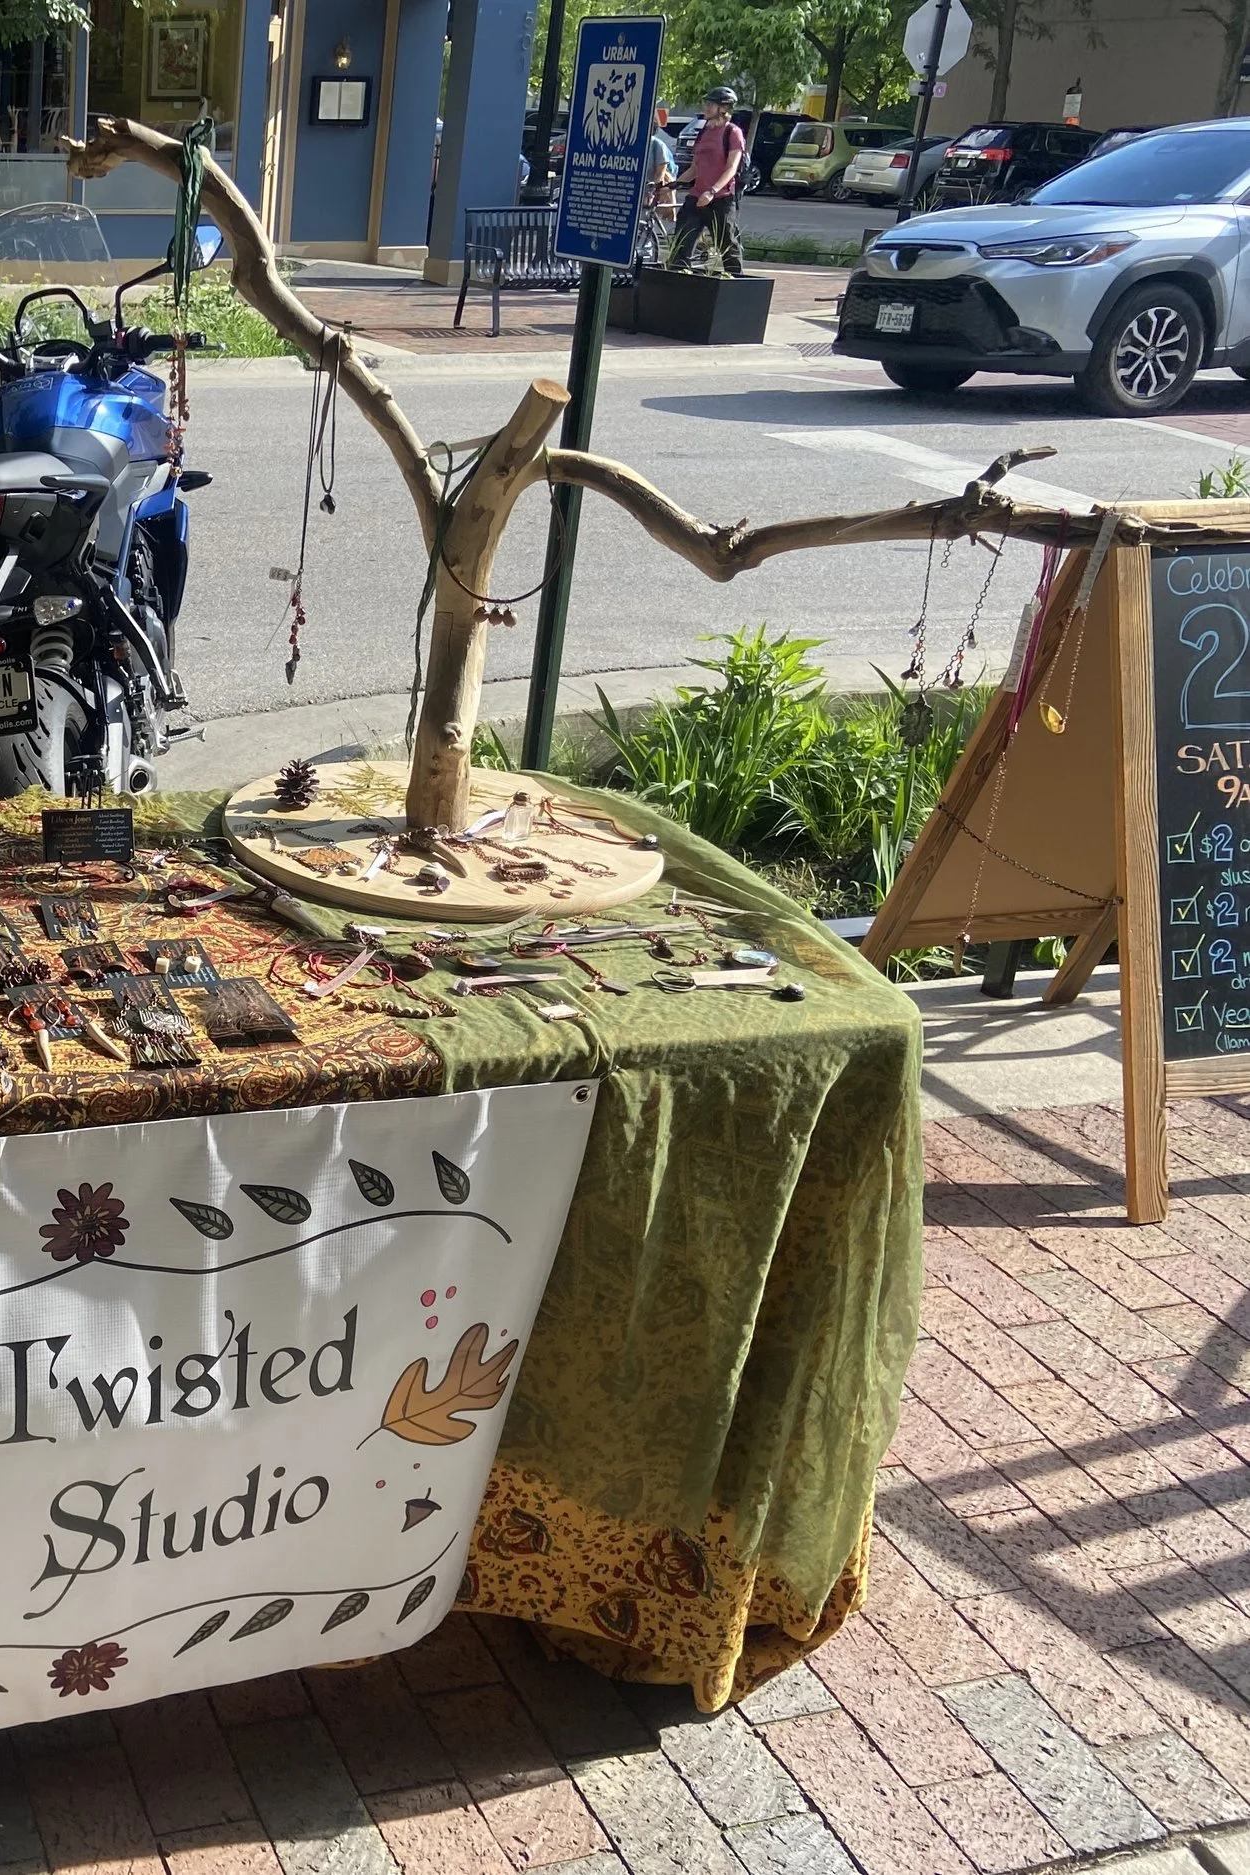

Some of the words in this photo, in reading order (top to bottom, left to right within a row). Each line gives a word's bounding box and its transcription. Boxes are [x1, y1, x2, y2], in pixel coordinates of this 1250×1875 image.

[602, 46, 637, 61] URBAN
[572, 152, 596, 168] RAIN
[600, 153, 639, 172] GARDEN
[1199, 823, 1234, 861] $2
[1205, 892, 1239, 926] $2
[1208, 939, 1236, 975] 2
[23, 1465, 330, 1620] Studio
